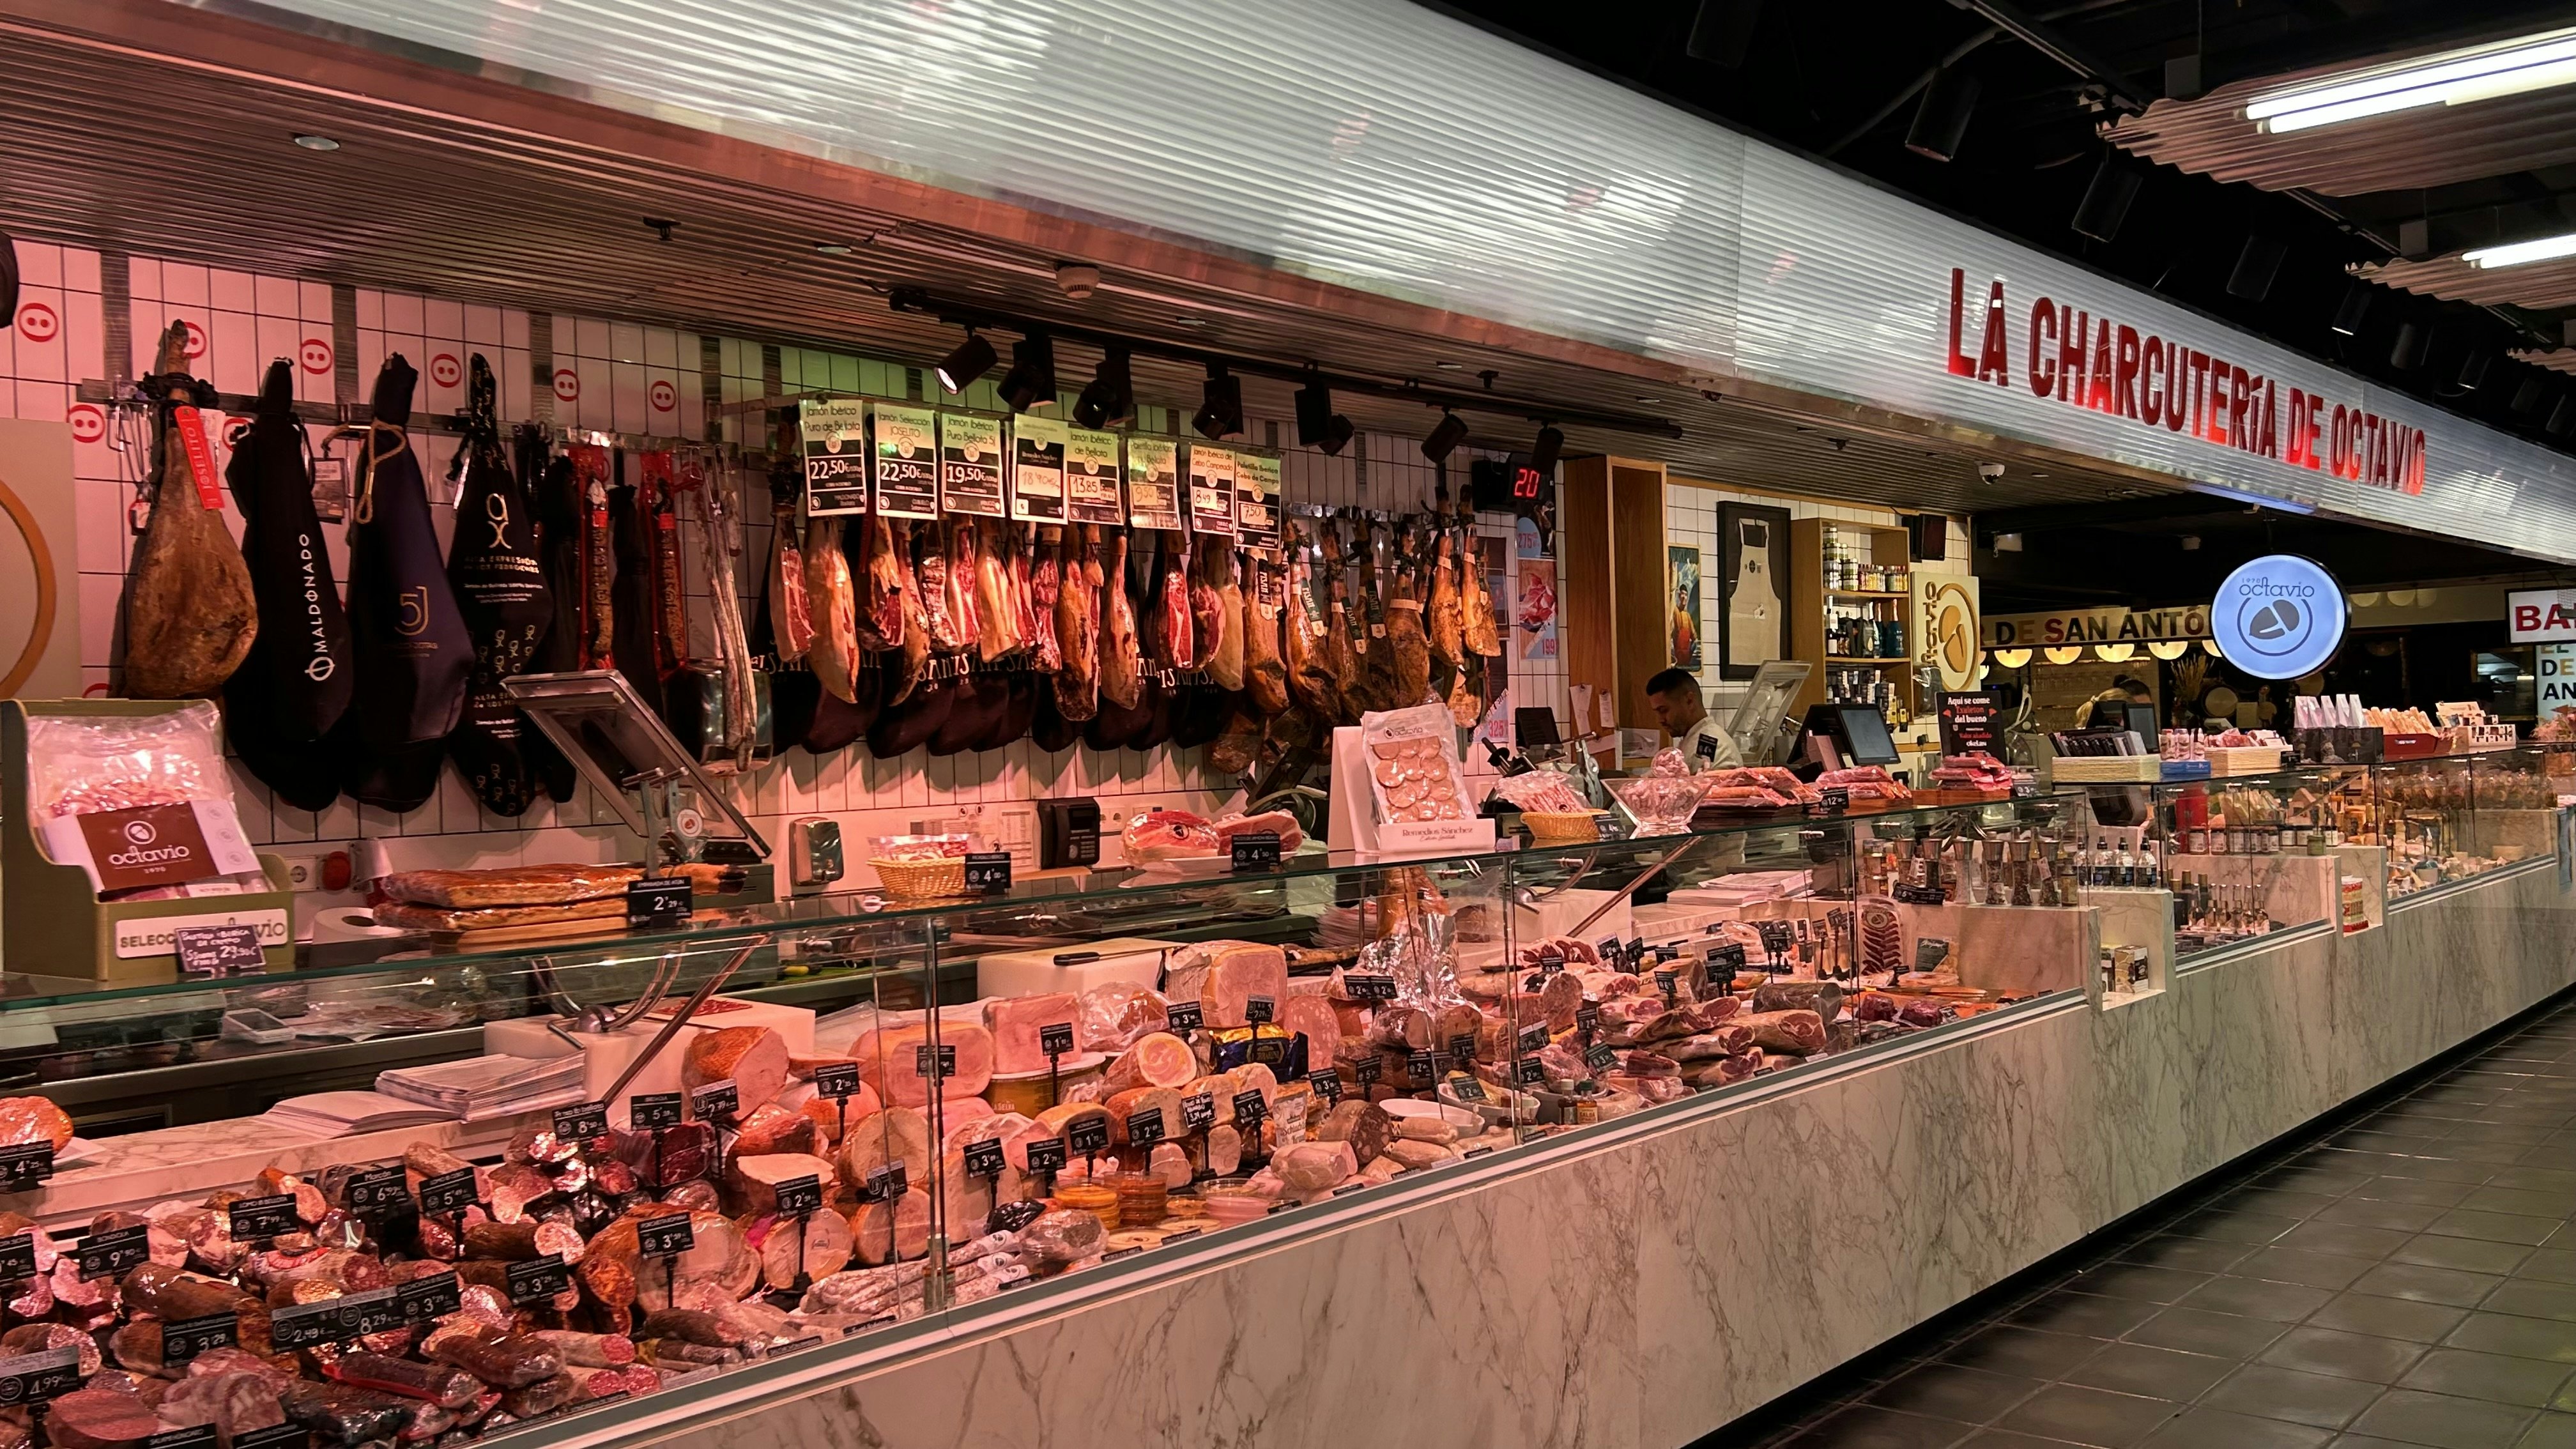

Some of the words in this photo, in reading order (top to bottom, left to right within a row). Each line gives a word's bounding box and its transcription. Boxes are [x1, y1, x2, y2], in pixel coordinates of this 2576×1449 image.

[1948, 268, 2009, 387] LA
[2285, 387, 2324, 471] DE
[2329, 403, 2426, 496] OCTAVIO
[1514, 468, 1540, 497] 20
[2239, 577, 2315, 597] octavio
[1920, 581, 1938, 664] tavio
[1995, 620, 2035, 645] DE
[2045, 616, 2107, 642] SAN
[2119, 608, 2212, 638] ANTÓ
[2515, 603, 2576, 631] BA
[2542, 658, 2575, 676] DE
[1948, 696, 1963, 706] Aquí
[108, 845, 190, 864] octavio
